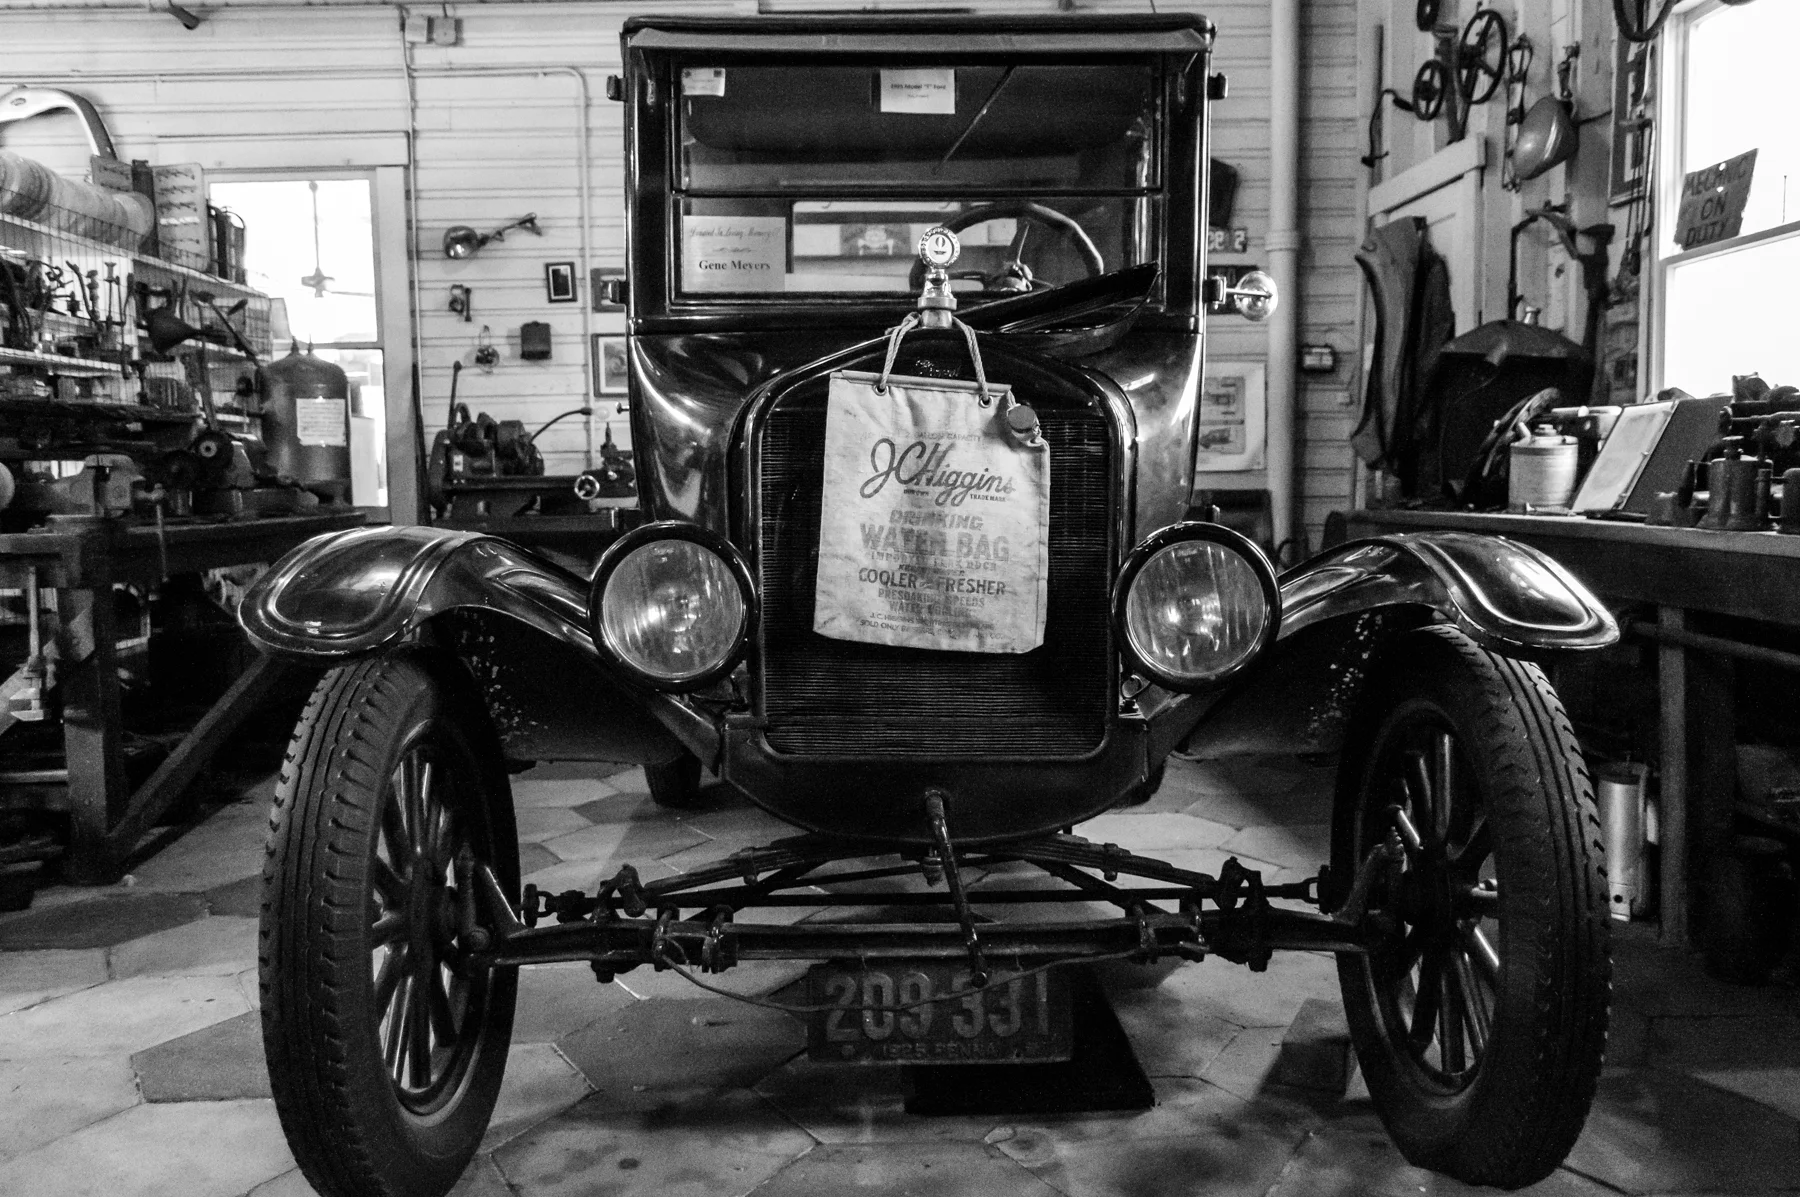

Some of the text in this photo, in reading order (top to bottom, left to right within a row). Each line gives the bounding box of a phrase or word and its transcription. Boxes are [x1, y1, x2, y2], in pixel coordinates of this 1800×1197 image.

[1700, 191, 1729, 221] ON
[1684, 217, 1730, 248] DUTY
[698, 260, 771, 274] Gene Meyers
[889, 509, 984, 531] DRINKING
[860, 522, 1010, 562] WATER BAG
[858, 567, 918, 589] COOLER
[937, 576, 1007, 596] FRESHER
[859, 619, 879, 629] SOLD
[880, 622, 899, 631] ONLY
